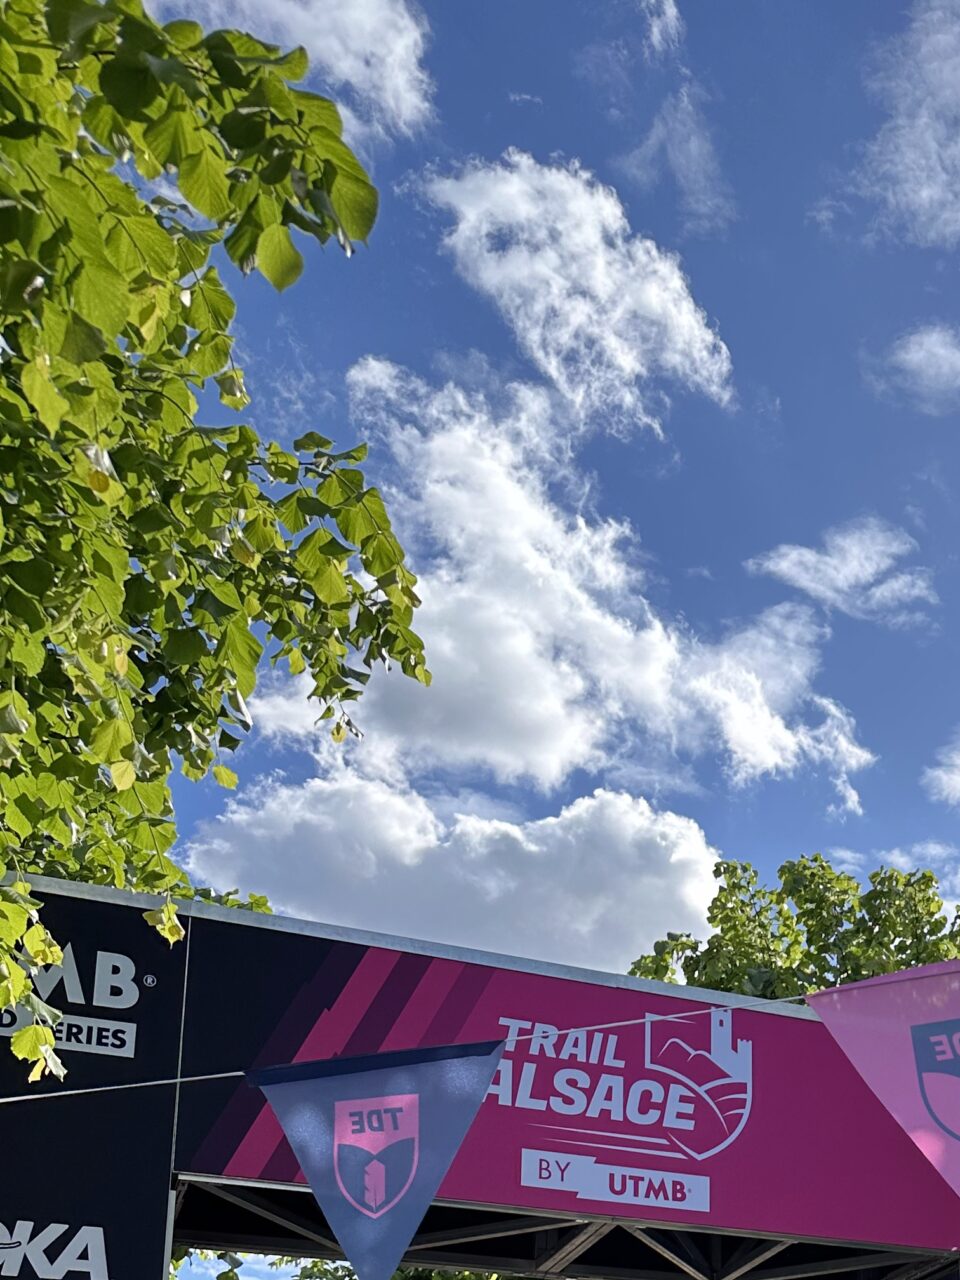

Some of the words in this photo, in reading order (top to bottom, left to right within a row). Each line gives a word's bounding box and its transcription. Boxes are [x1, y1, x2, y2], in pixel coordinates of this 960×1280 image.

[36, 1019, 127, 1049] ERIES
[498, 1016, 626, 1069] TRAIL
[482, 1058, 697, 1131] ALSACE
[537, 1158, 571, 1183] BY
[608, 1172, 687, 1202] UTMB
